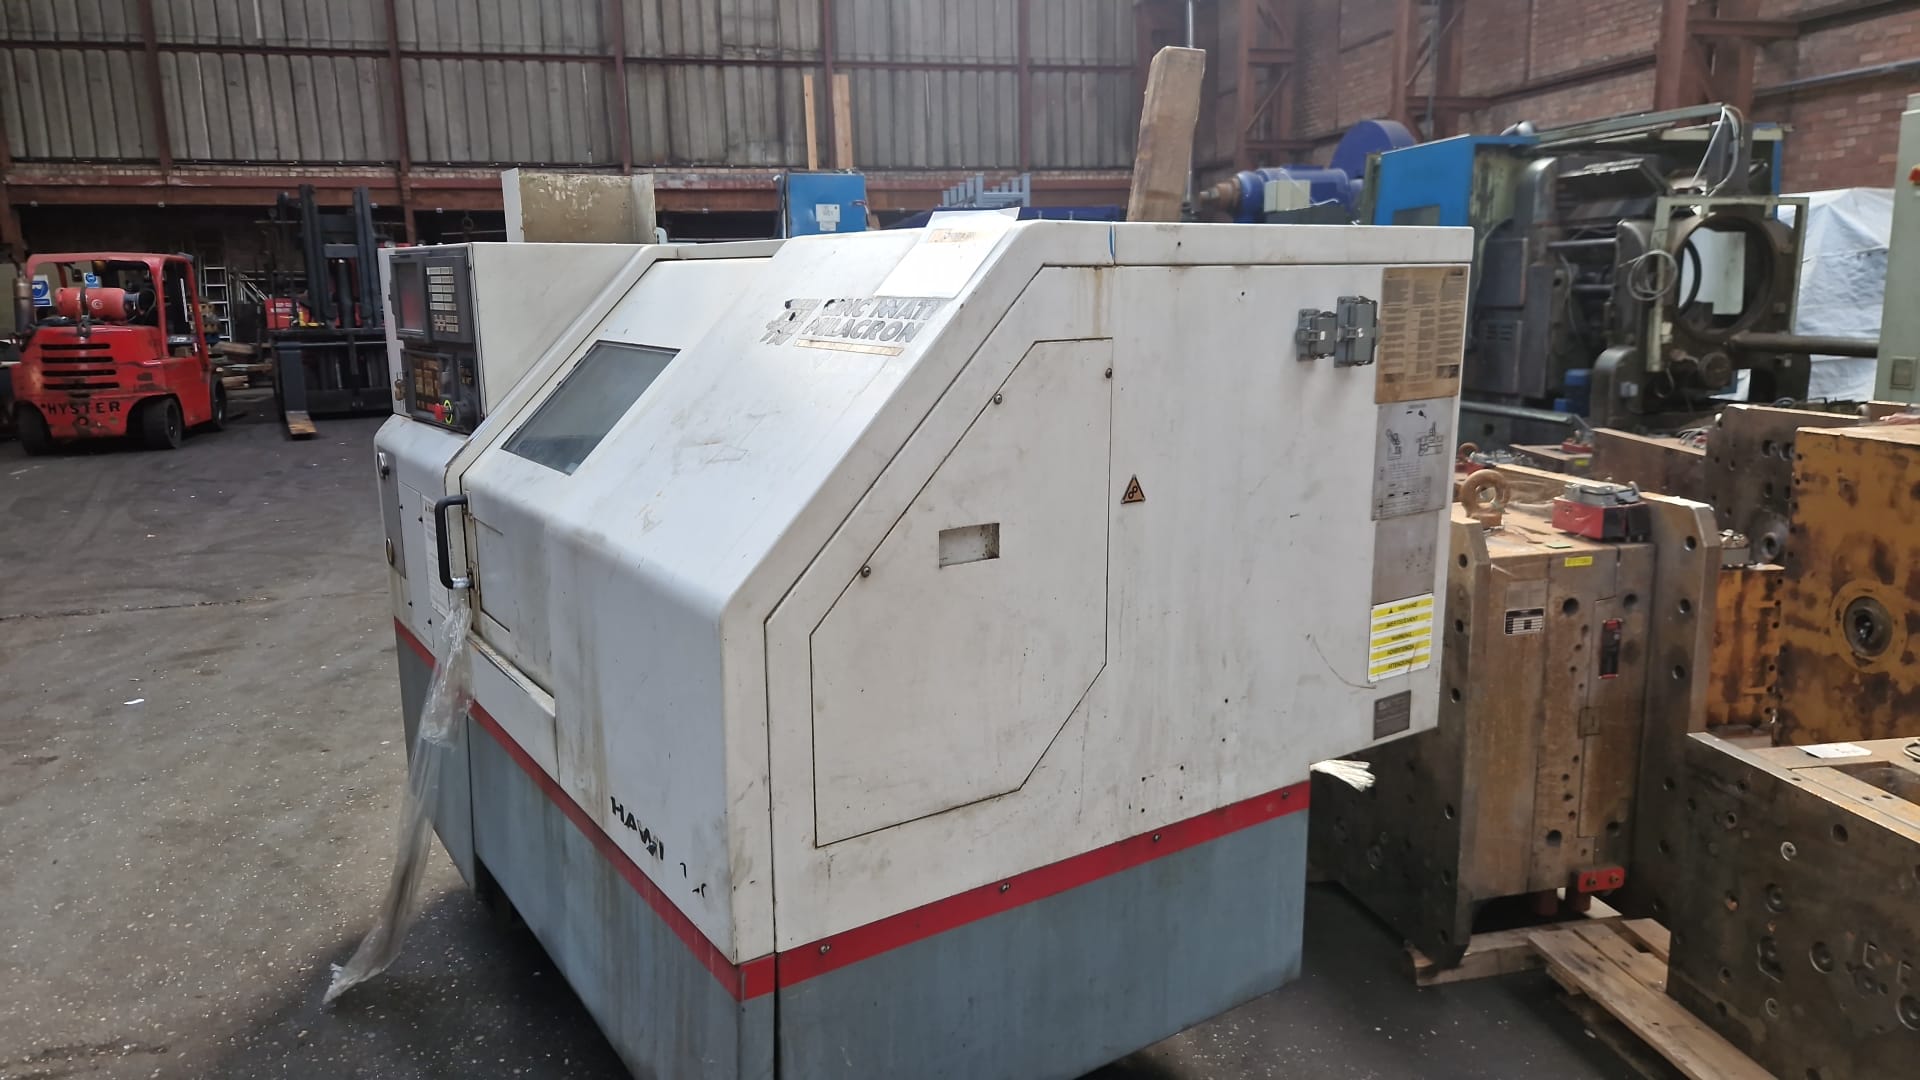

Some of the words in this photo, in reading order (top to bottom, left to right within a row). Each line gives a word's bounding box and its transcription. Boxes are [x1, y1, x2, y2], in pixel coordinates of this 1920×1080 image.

[821, 298, 941, 322] CINCNNATI
[802, 317, 926, 343] MILACRON
[47, 401, 121, 415] HYSTER
